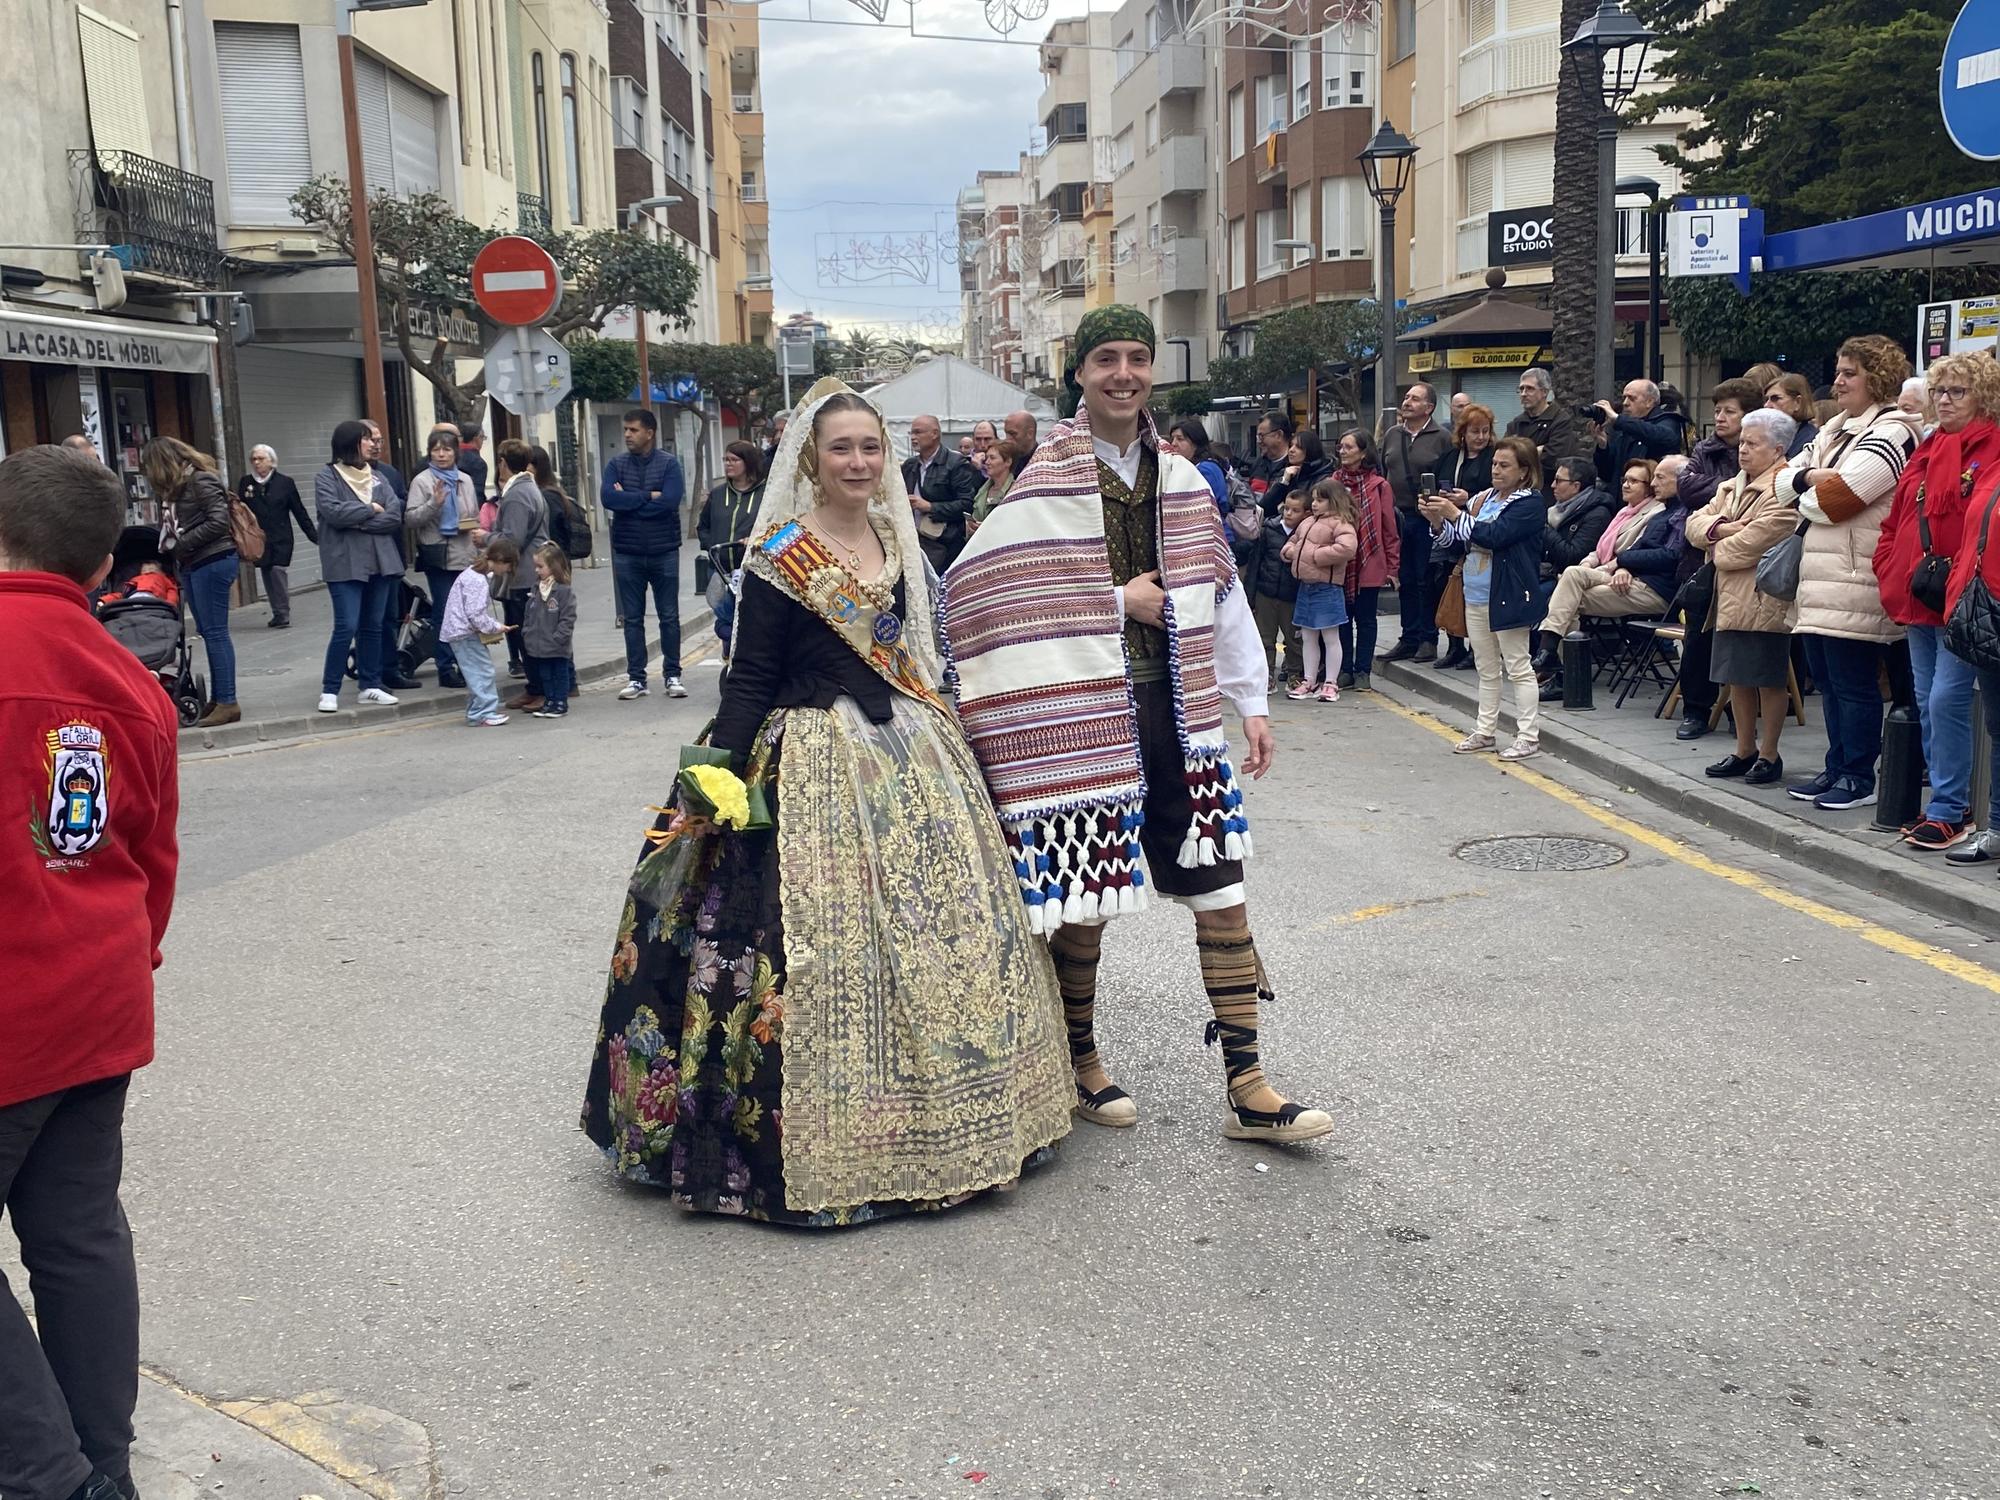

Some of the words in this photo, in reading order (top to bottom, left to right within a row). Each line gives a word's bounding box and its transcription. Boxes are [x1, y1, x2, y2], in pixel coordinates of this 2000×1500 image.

[1907, 195, 2000, 241] Much
[1503, 240, 1547, 253] ESTUDIO
[437, 303, 480, 345] Solsona
[6, 331, 29, 354] LA
[35, 334, 81, 358] CASA
[85, 339, 114, 362] DEL
[119, 337, 163, 365] MÒBIL
[1472, 354, 1521, 363] 120.000.000
[811, 572, 834, 594] 2022
[62, 733, 75, 743] EL
[76, 734, 99, 745] GRILL
[69, 726, 94, 735] FALLA
